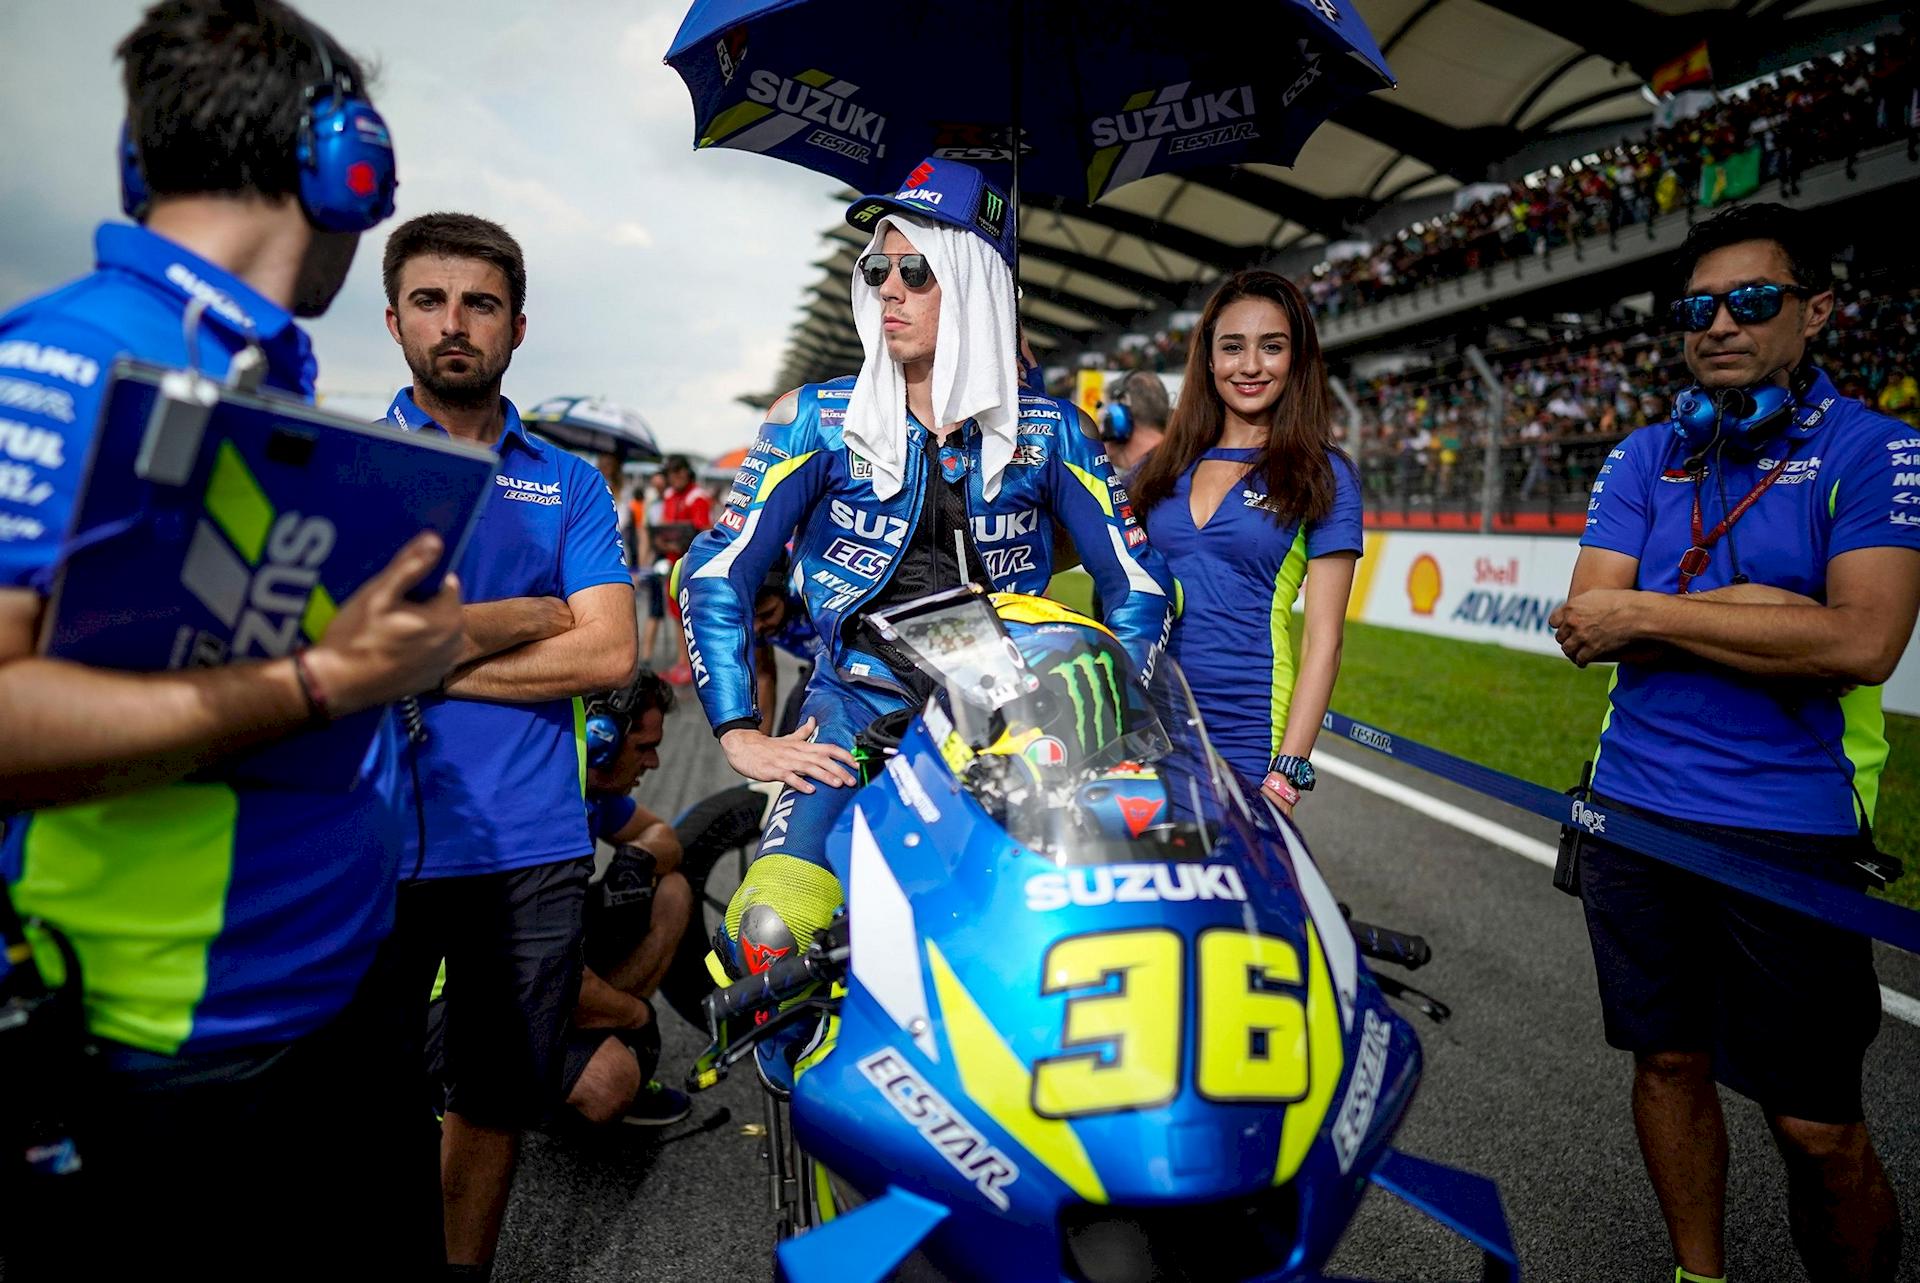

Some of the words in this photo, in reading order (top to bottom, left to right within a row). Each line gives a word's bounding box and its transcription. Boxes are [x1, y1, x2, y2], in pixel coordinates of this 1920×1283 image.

[746, 69, 887, 145] SUZUKI
[1090, 83, 1257, 148] SUZUKI
[806, 129, 871, 165] ECSTAR
[1168, 121, 1261, 156] ECSTAR
[854, 204, 885, 223] 36
[1018, 409, 1061, 421] UZUKI
[504, 489, 563, 506] ECSTAR
[829, 499, 910, 549] SUZ
[969, 507, 1038, 545] UKI
[1473, 556, 1520, 585] Shell
[679, 587, 711, 689] SUZUKI
[1349, 722, 1393, 754] ECSTAR
[1571, 800, 1606, 835] flex
[1024, 862, 1247, 912] SUZUKI
[1029, 924, 1311, 1120] 36
[857, 1046, 1020, 1213] ECSTAR
